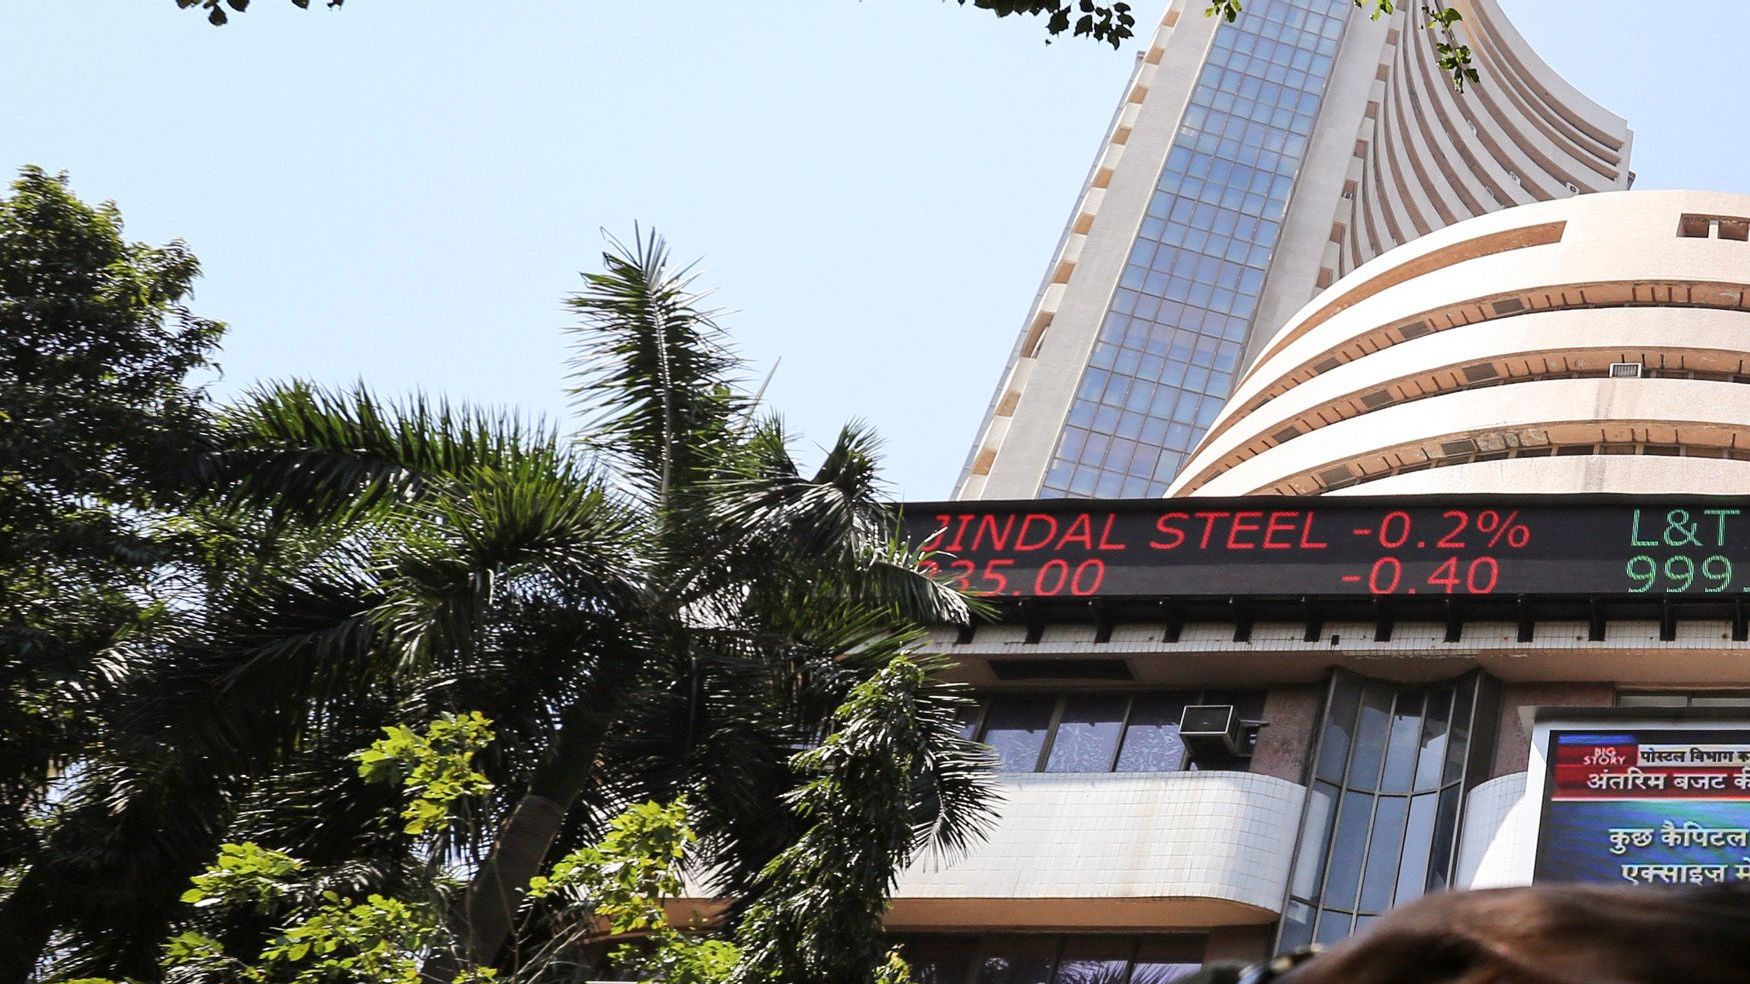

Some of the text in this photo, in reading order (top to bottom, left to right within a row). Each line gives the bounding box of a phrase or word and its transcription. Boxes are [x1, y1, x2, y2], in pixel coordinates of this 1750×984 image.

[921, 509, 1531, 551] JINDAL STEEL -0.2%
[1630, 509, 1740, 547] L&T
[1341, 556, 1500, 596] -0.40
[1583, 756, 1627, 766] STORY
[1587, 767, 1667, 790] अंतरिम
[1672, 772, 1728, 790] बजट
[1608, 827, 1655, 855] कुछ
[1660, 820, 1750, 848] कैपिटल
